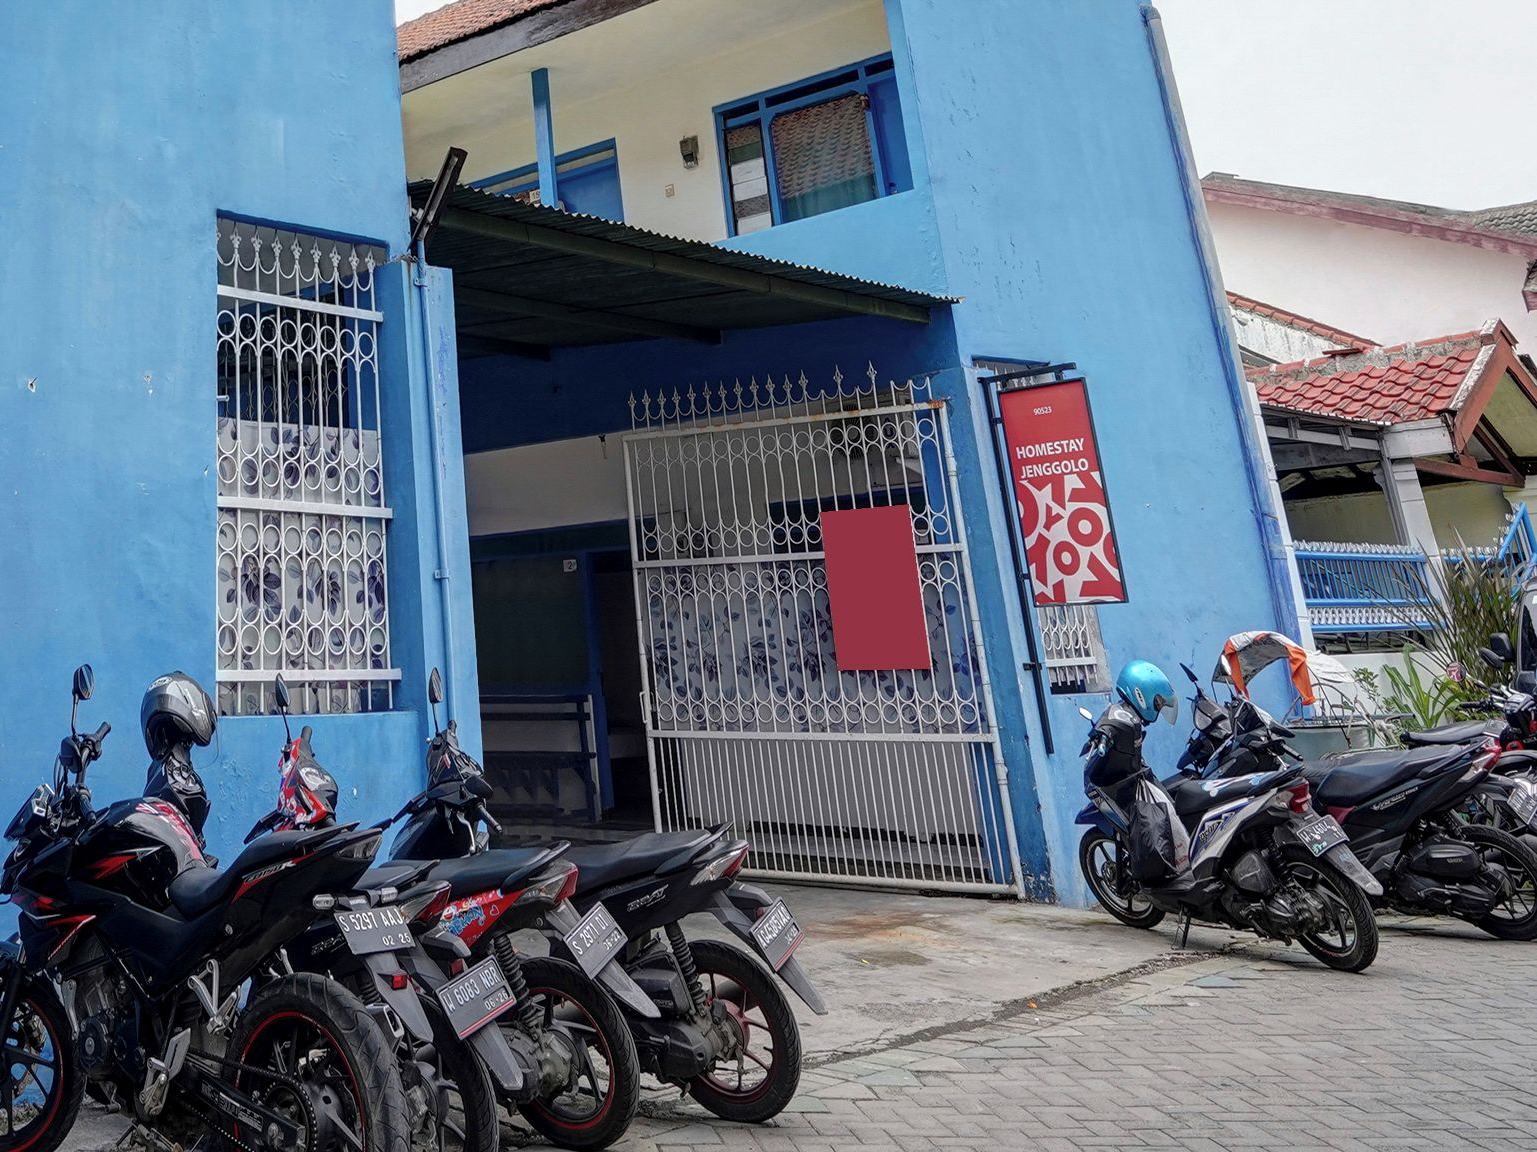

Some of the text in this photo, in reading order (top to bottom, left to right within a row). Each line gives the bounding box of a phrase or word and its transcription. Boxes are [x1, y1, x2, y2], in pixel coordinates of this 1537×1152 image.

[1033, 406, 1052, 415] 90523
[1015, 438, 1084, 459] HOMESTAY
[1020, 458, 1089, 479] JENGGOLO
[338, 915, 350, 932] S
[349, 911, 379, 931] 5297
[382, 936, 395, 946] 02
[572, 941, 583, 955] S
[580, 922, 600, 948] 2971
[443, 966, 501, 1013] W 6083 NBR
